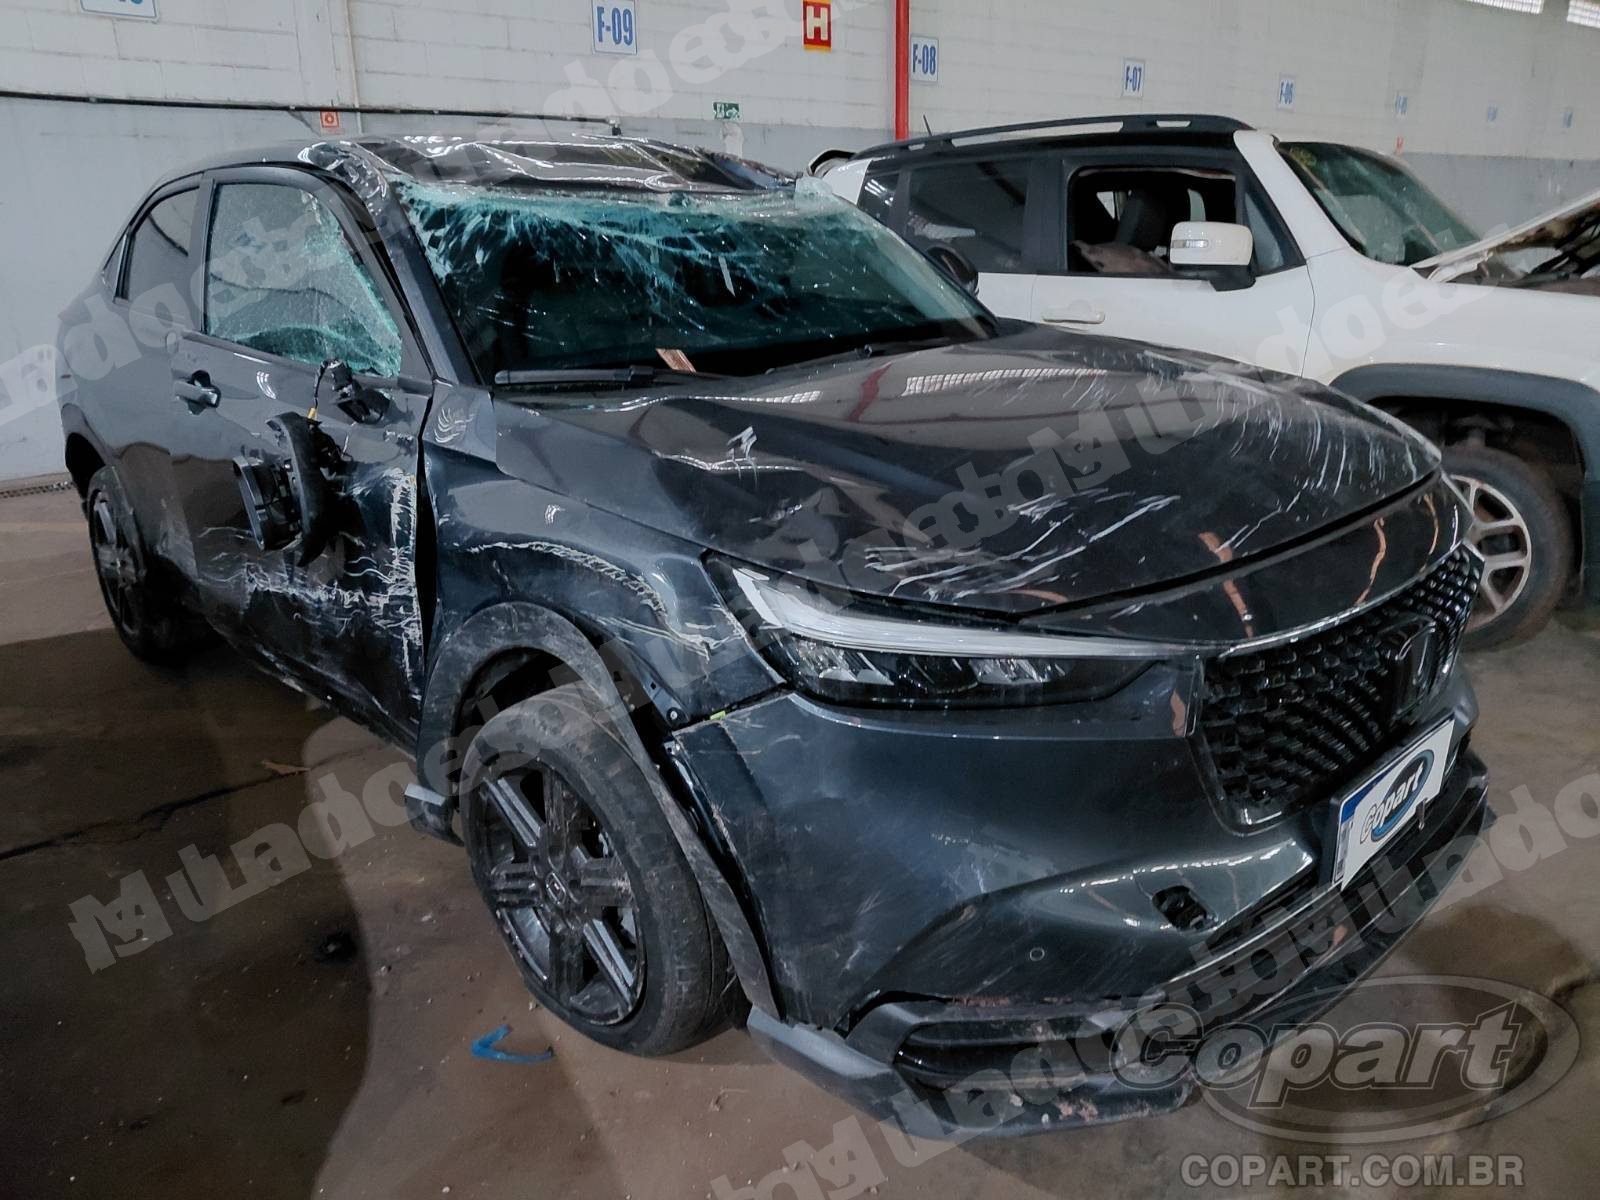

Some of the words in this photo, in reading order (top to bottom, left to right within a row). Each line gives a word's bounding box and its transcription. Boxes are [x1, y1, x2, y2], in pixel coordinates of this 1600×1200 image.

[597, 6, 633, 46] F-09
[806, 6, 828, 41] H
[912, 44, 936, 75] F-08
[1360, 760, 1424, 845] Copart
